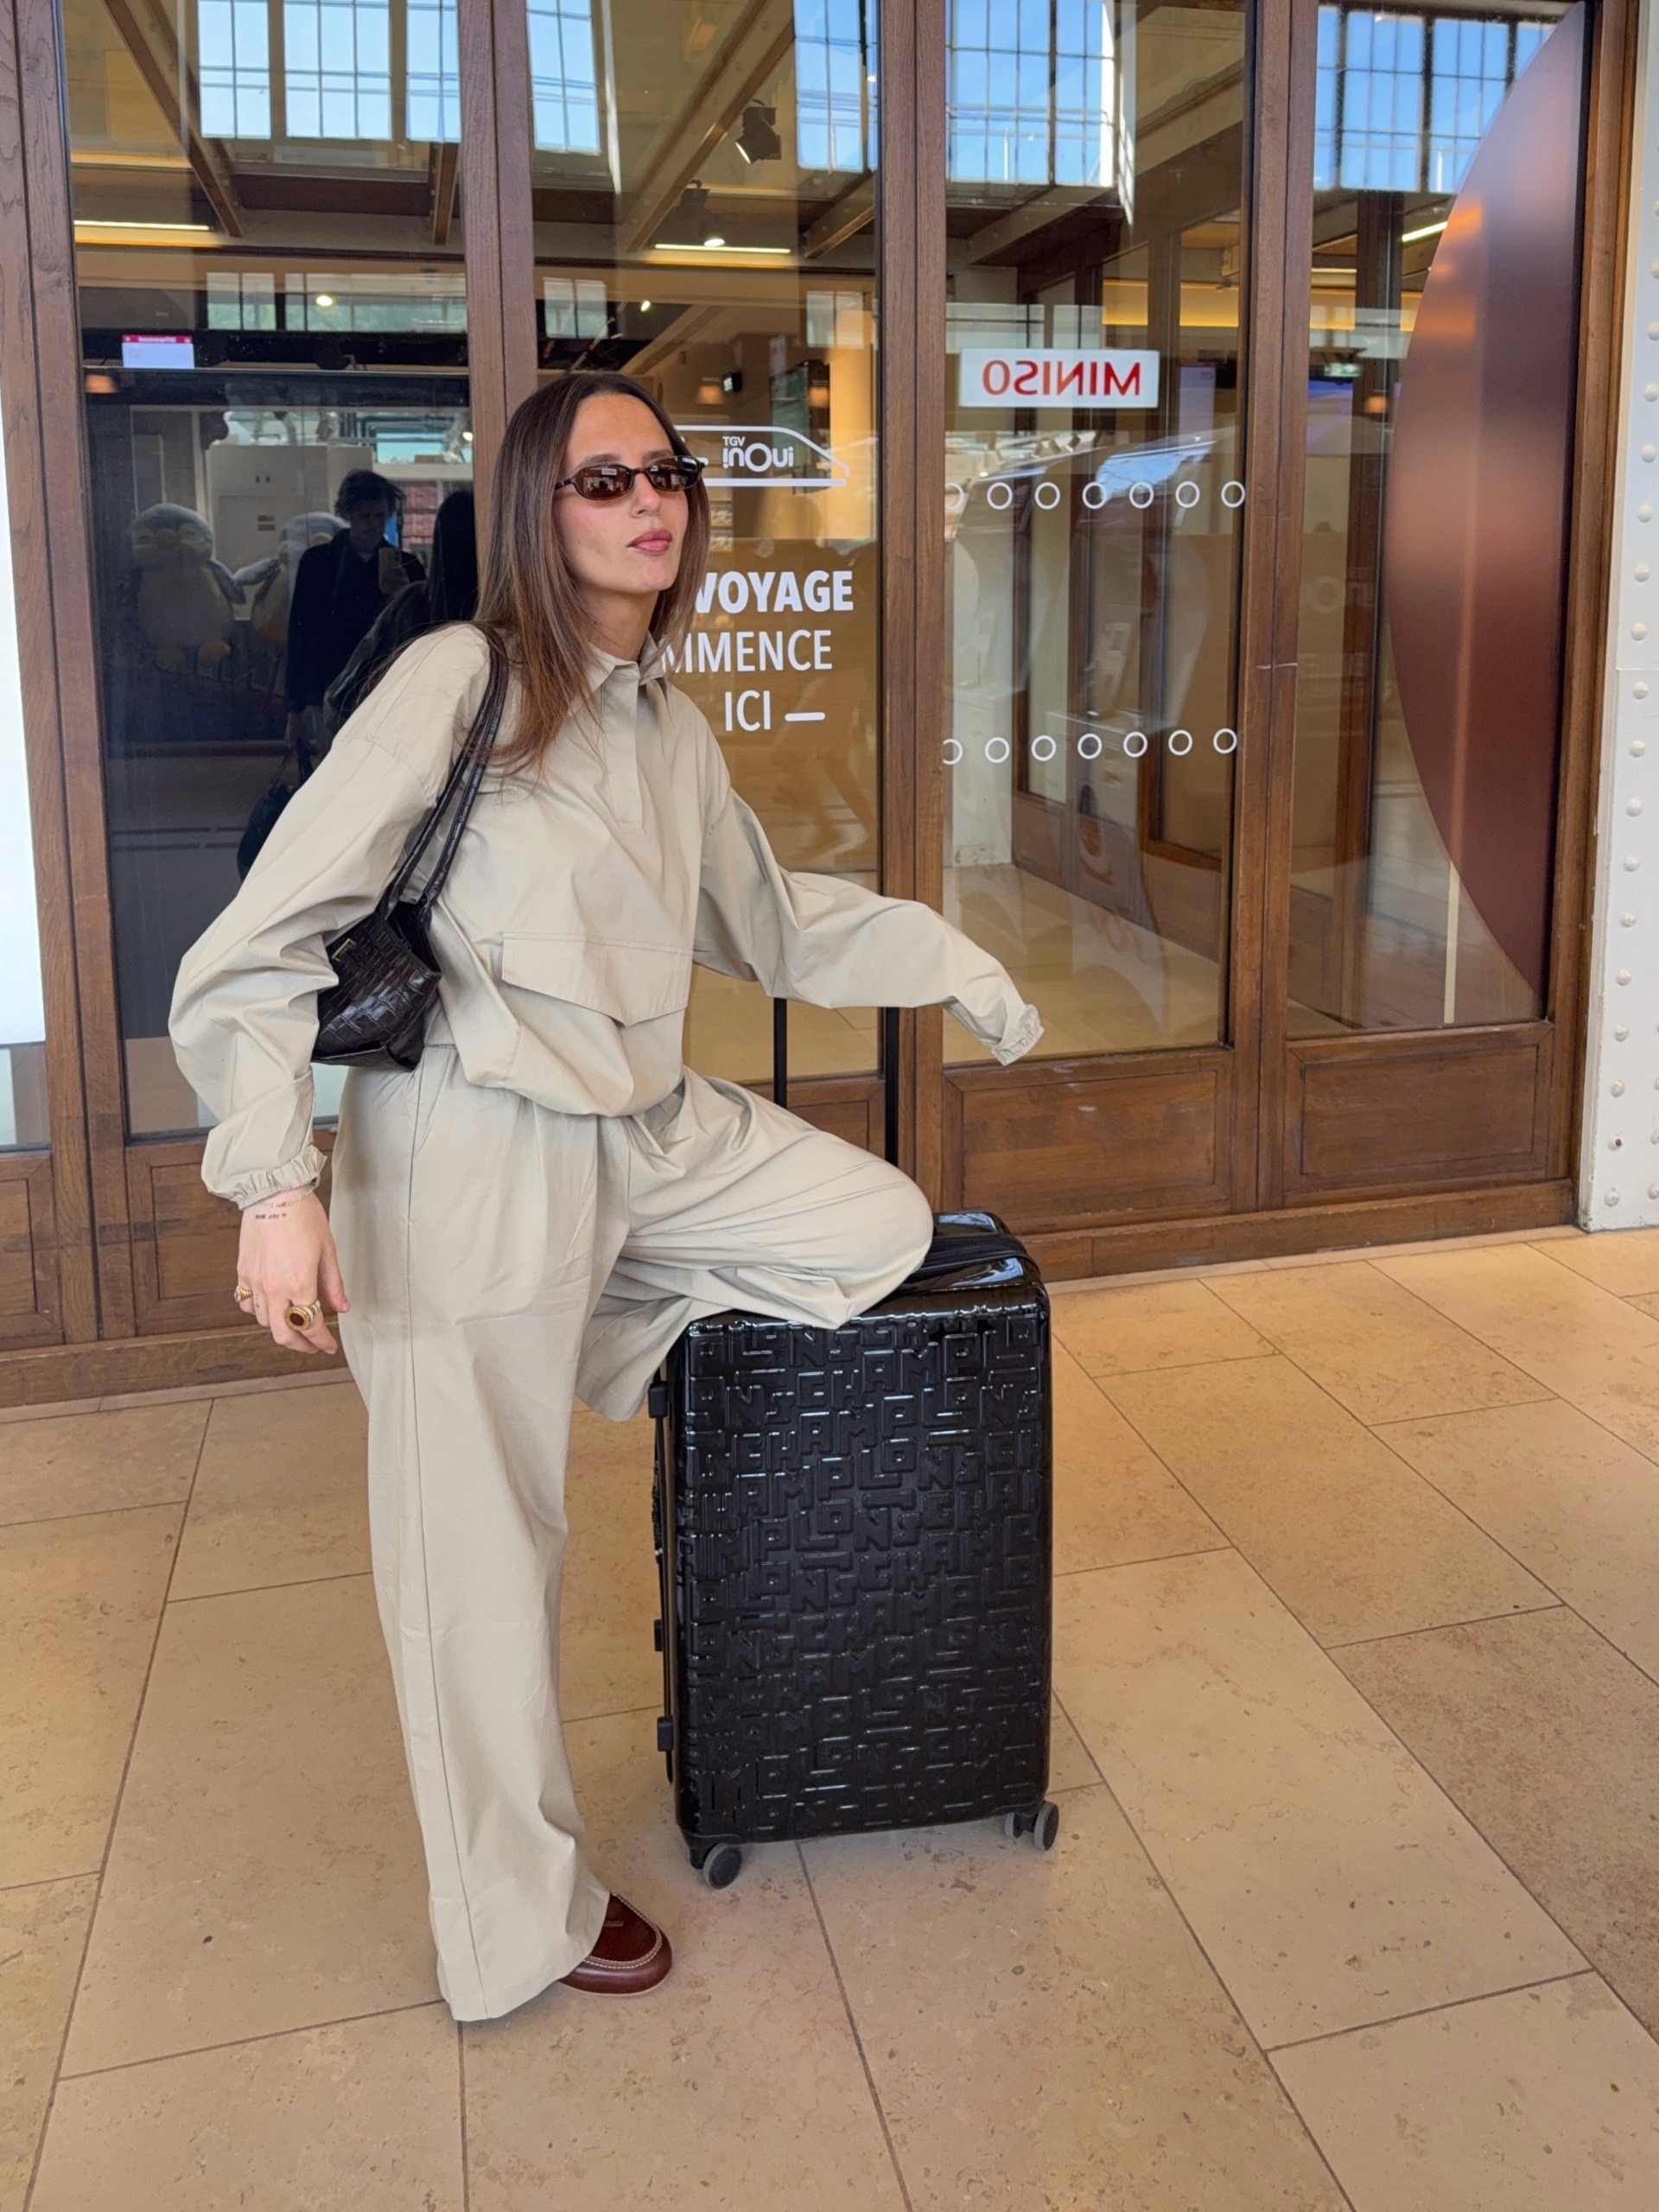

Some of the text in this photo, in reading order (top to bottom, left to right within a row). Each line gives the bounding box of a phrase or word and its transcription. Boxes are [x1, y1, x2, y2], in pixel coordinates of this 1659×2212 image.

[721, 436, 746, 447] TGV
[695, 570, 854, 613] VOYAGE
[724, 690, 771, 731] ICI
